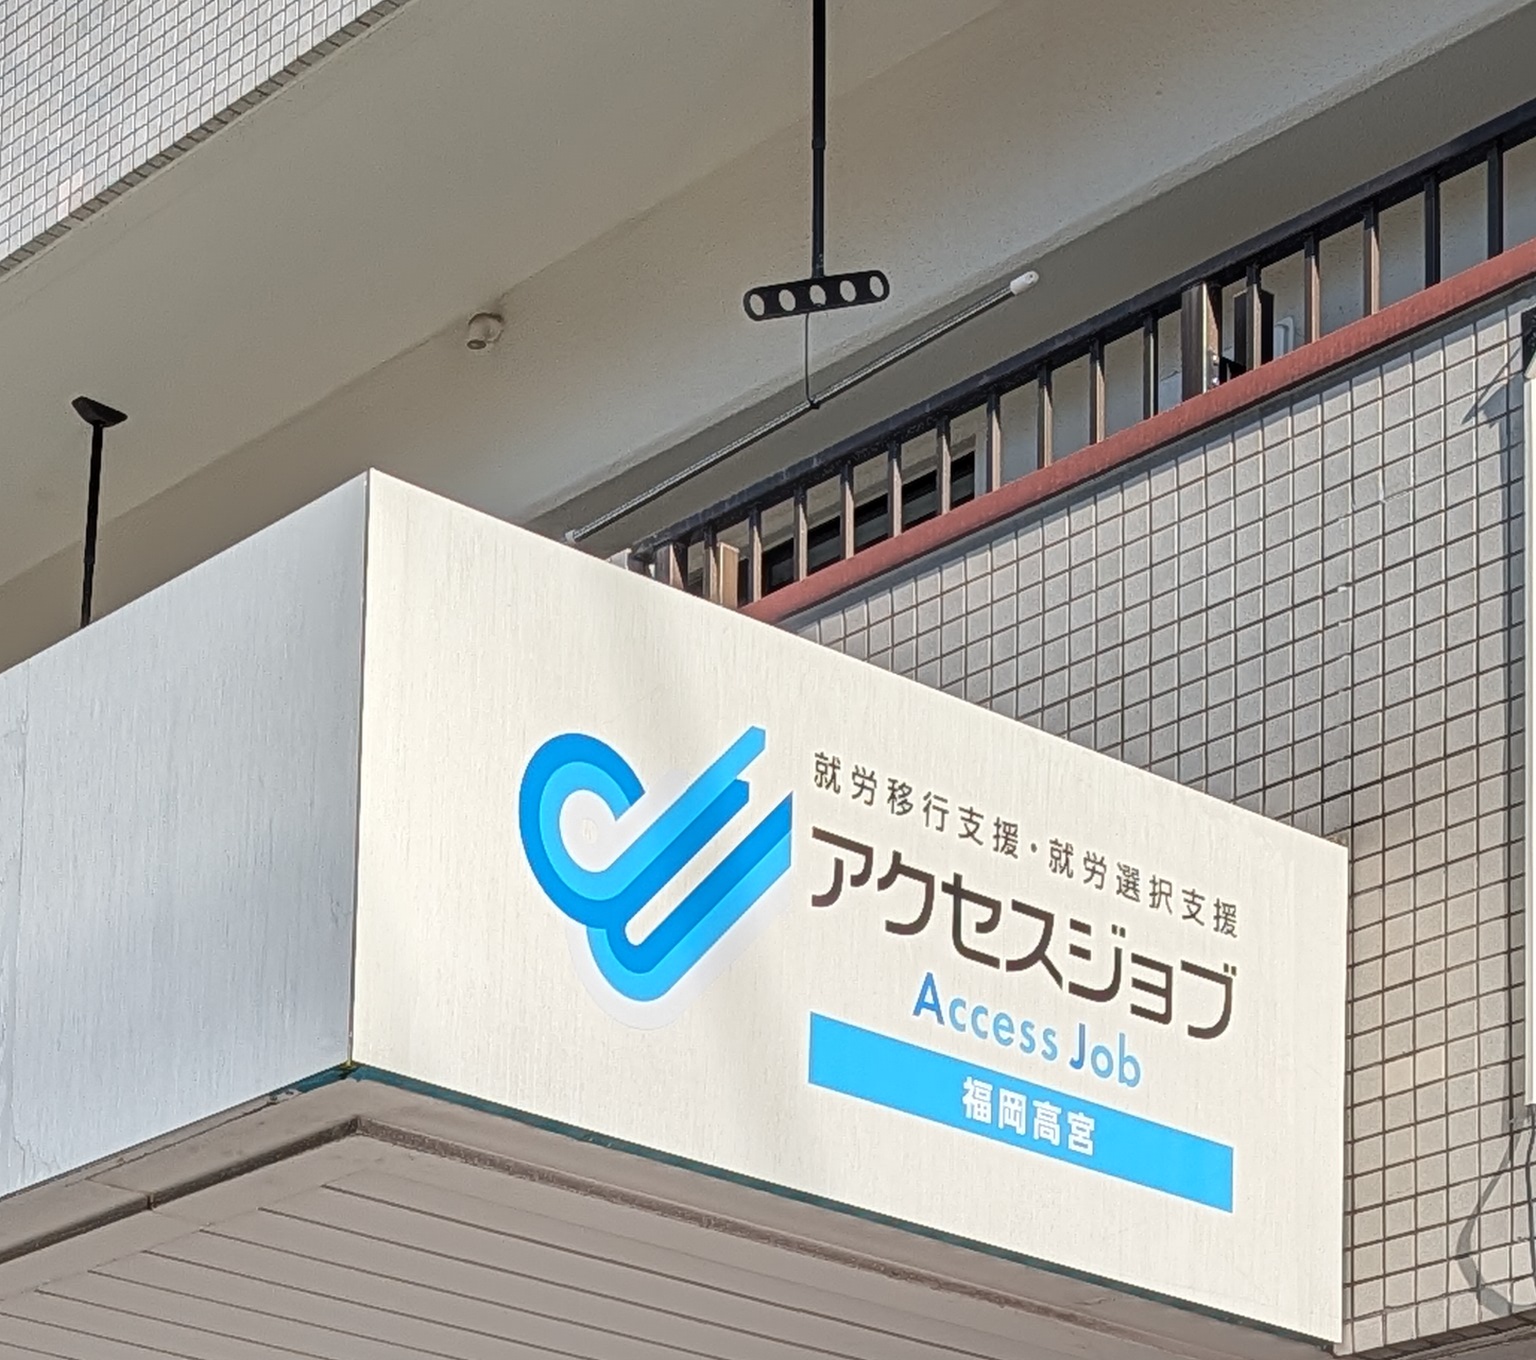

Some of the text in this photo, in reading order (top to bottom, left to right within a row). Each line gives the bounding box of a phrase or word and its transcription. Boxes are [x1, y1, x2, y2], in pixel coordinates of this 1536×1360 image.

[813, 751, 1241, 938] 就労移行支援・就労選択支援
[811, 826, 1239, 1040] アクセスジョブ
[912, 972, 1143, 1089] Access Job
[962, 1076, 1096, 1158] 福岡高宮
